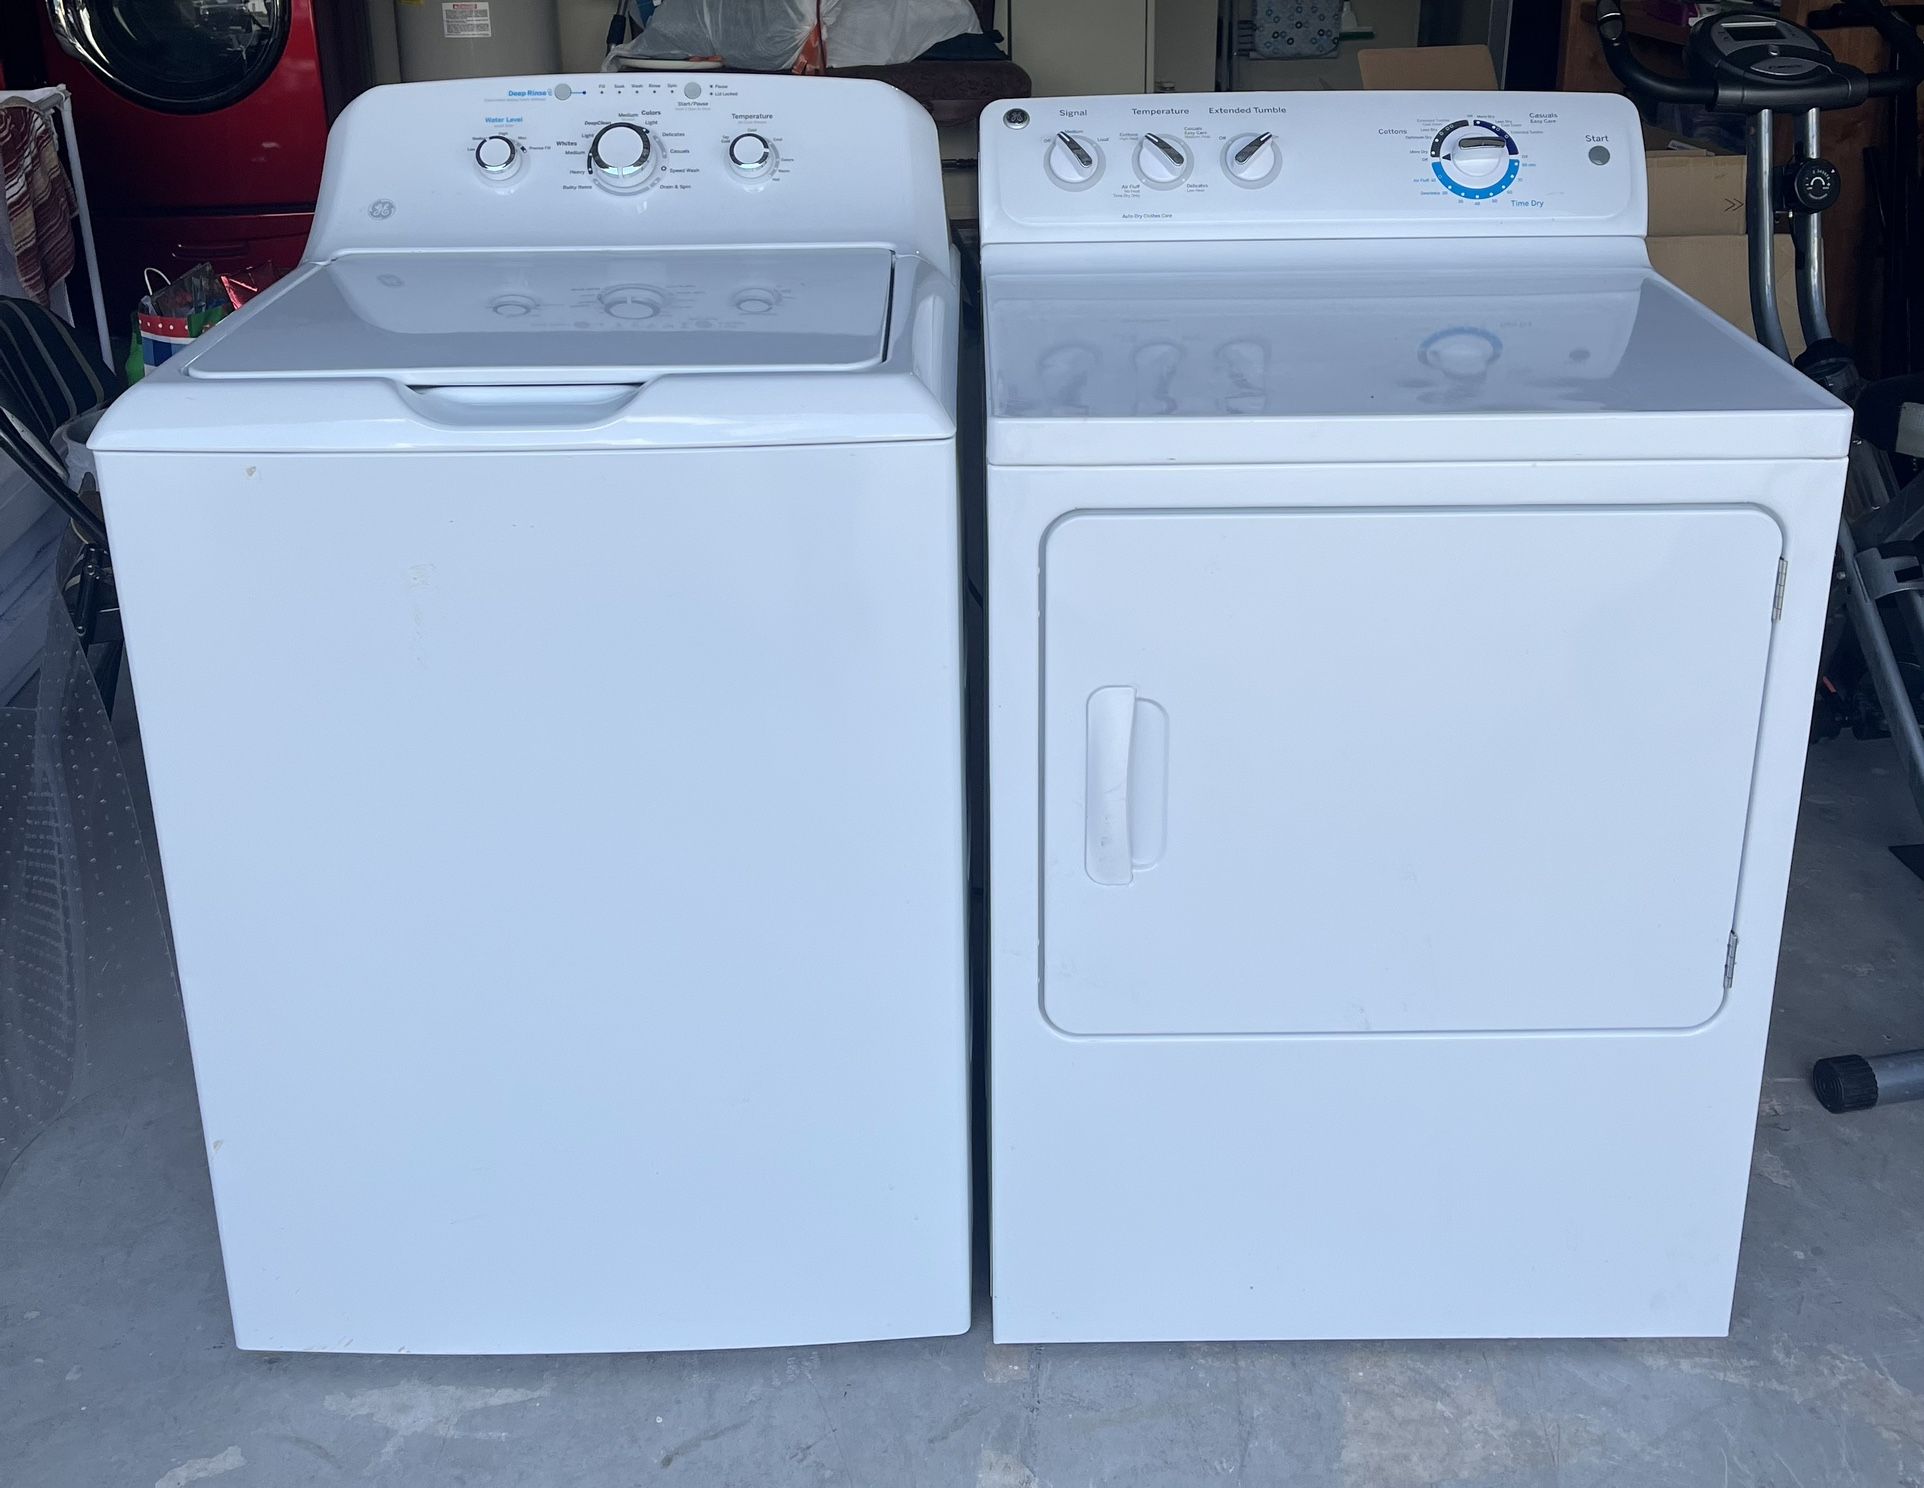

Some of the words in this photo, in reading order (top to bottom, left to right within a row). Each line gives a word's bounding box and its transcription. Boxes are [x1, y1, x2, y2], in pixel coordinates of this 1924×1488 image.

[508, 90, 526, 98] Deep
[1059, 109, 1088, 118] Signal
[1131, 108, 1190, 116] Temperature
[1253, 106, 1287, 114] Tumble
[1585, 134, 1609, 142] Start
[1531, 200, 1544, 208] Dry
